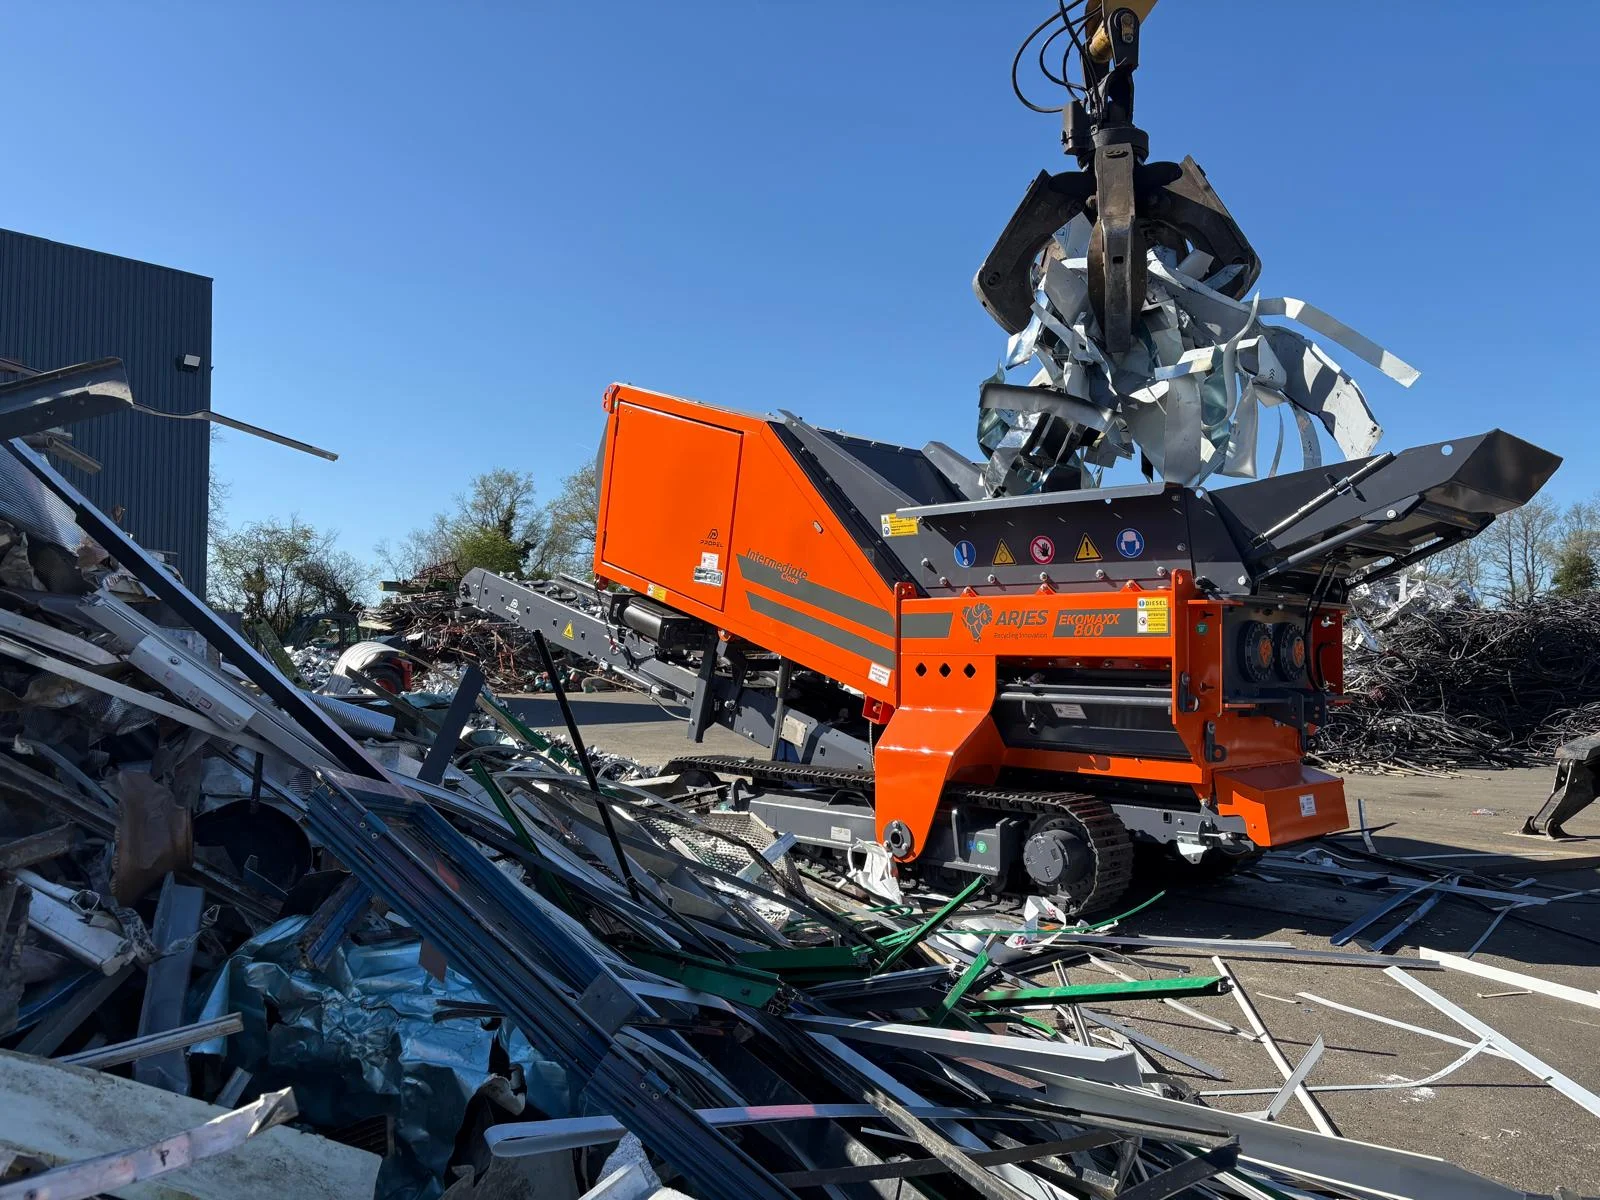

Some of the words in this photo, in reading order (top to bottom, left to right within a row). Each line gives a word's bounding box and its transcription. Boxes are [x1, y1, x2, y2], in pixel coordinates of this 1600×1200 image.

[746, 548, 808, 578] Intermediate
[995, 609, 1048, 628] ARJES
[1058, 613, 1120, 624] EKOMAXX
[1074, 623, 1104, 636] 800
